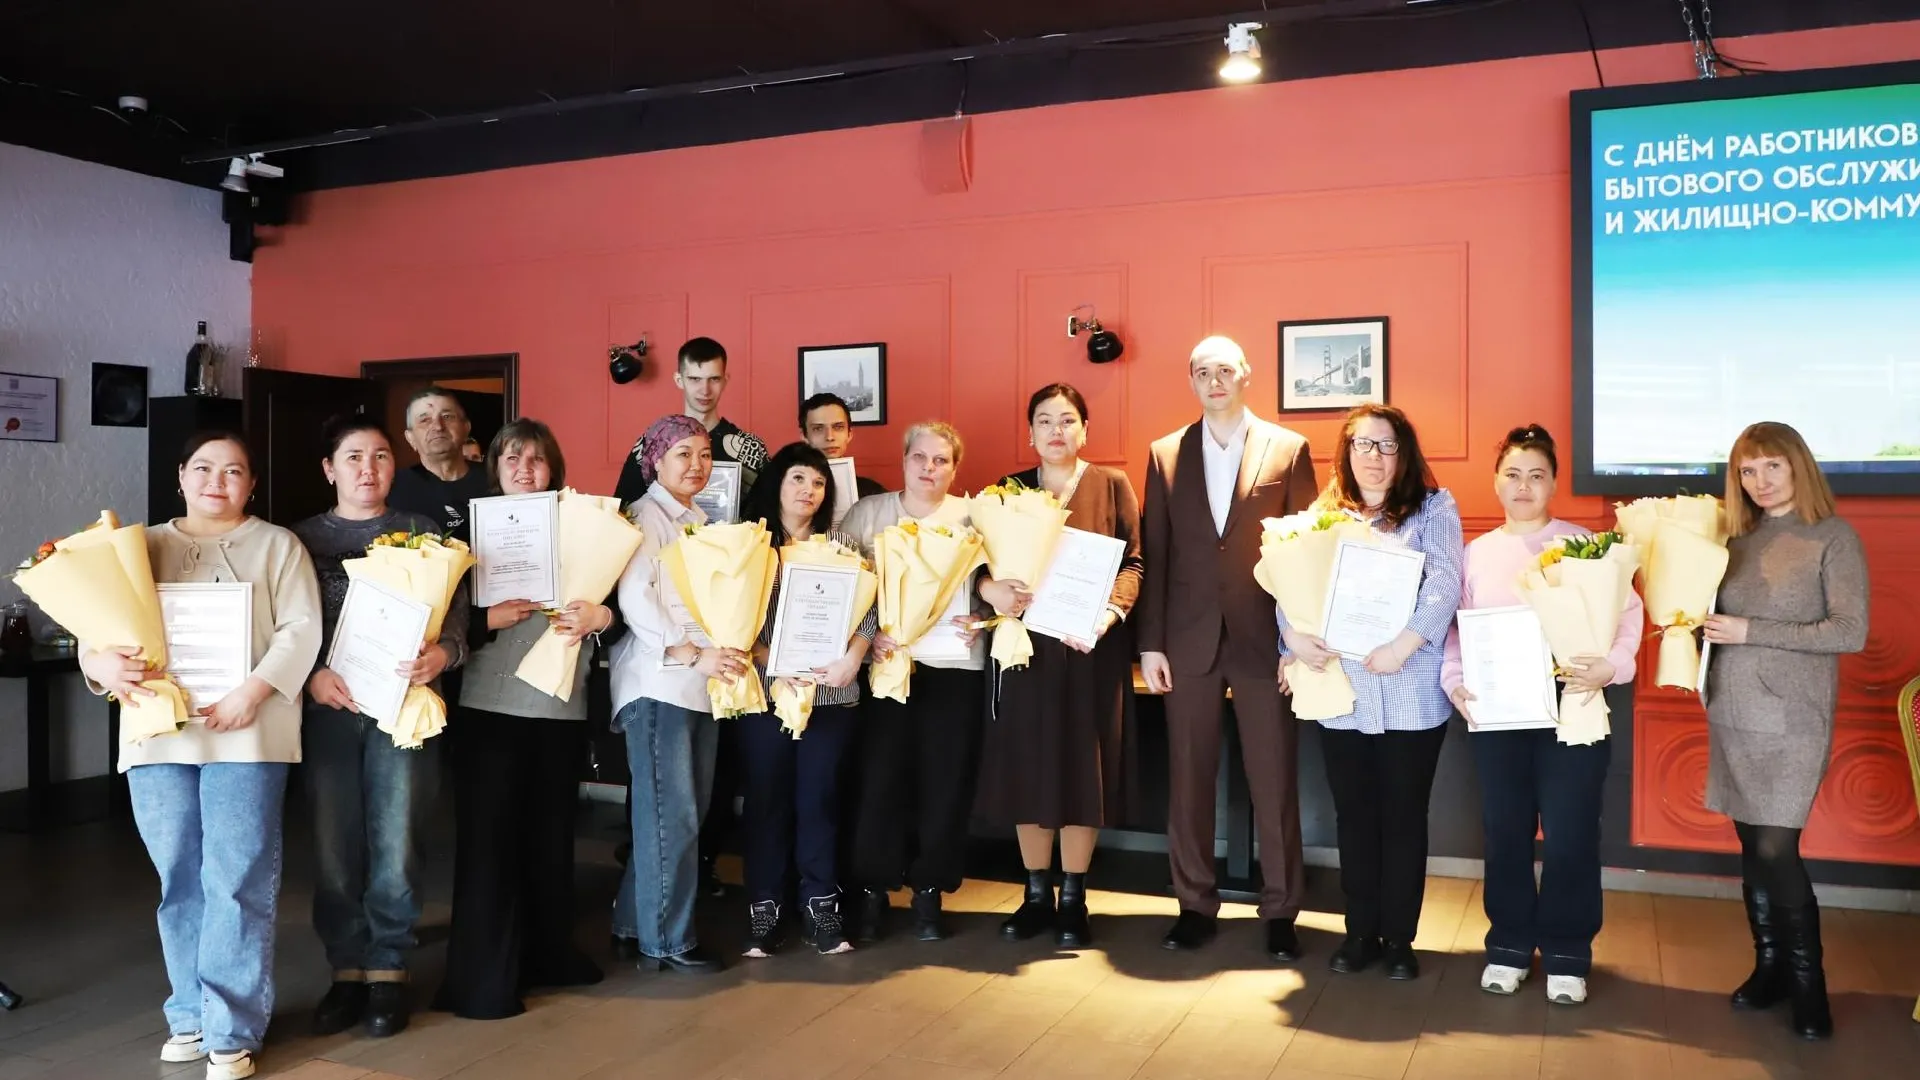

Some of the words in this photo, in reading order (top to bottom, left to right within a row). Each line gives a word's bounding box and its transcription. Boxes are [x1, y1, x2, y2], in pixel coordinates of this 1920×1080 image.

[1604, 144, 1624, 166] С
[1633, 133, 1714, 168] ДНЁМ
[1725, 122, 1918, 159] РАБОТНИКОВ
[1605, 168, 1763, 201] БЫТОВОГО
[1605, 211, 1623, 235] И
[1632, 192, 1920, 234] ЖИЛИЩНО-КОММУ
